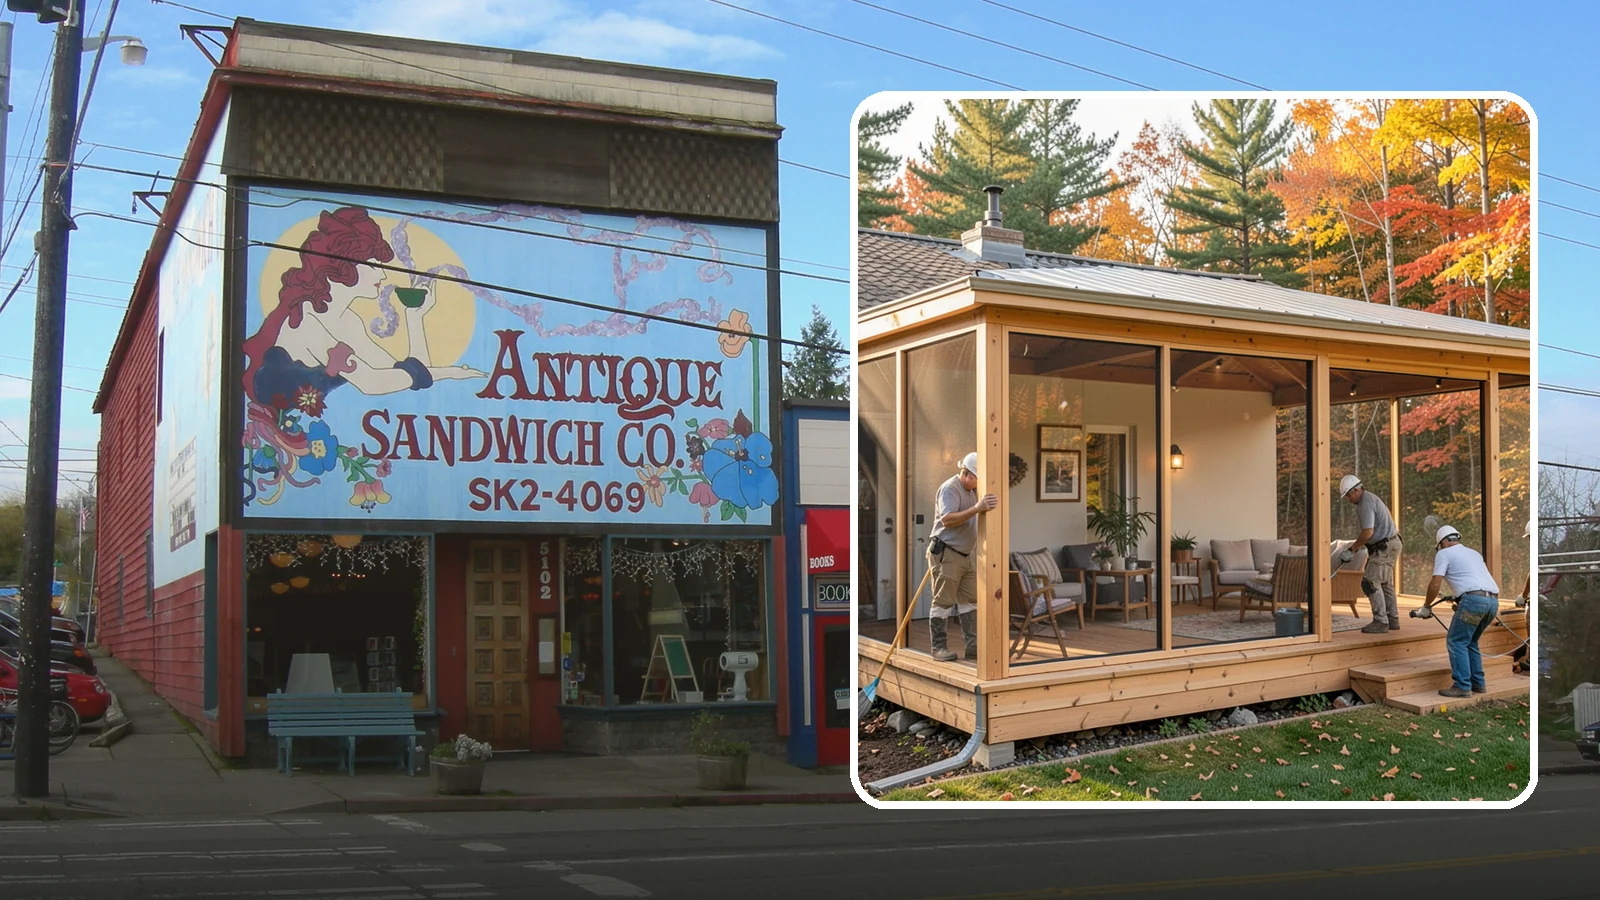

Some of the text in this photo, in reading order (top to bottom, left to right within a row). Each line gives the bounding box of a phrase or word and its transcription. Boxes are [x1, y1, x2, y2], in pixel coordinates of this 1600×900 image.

[475, 329, 723, 421] ANTIQUE
[362, 408, 685, 469] SANDWICH CO.
[468, 477, 646, 512] SK2-4069
[540, 542, 553, 599] 5102
[809, 555, 834, 568] BOOKS
